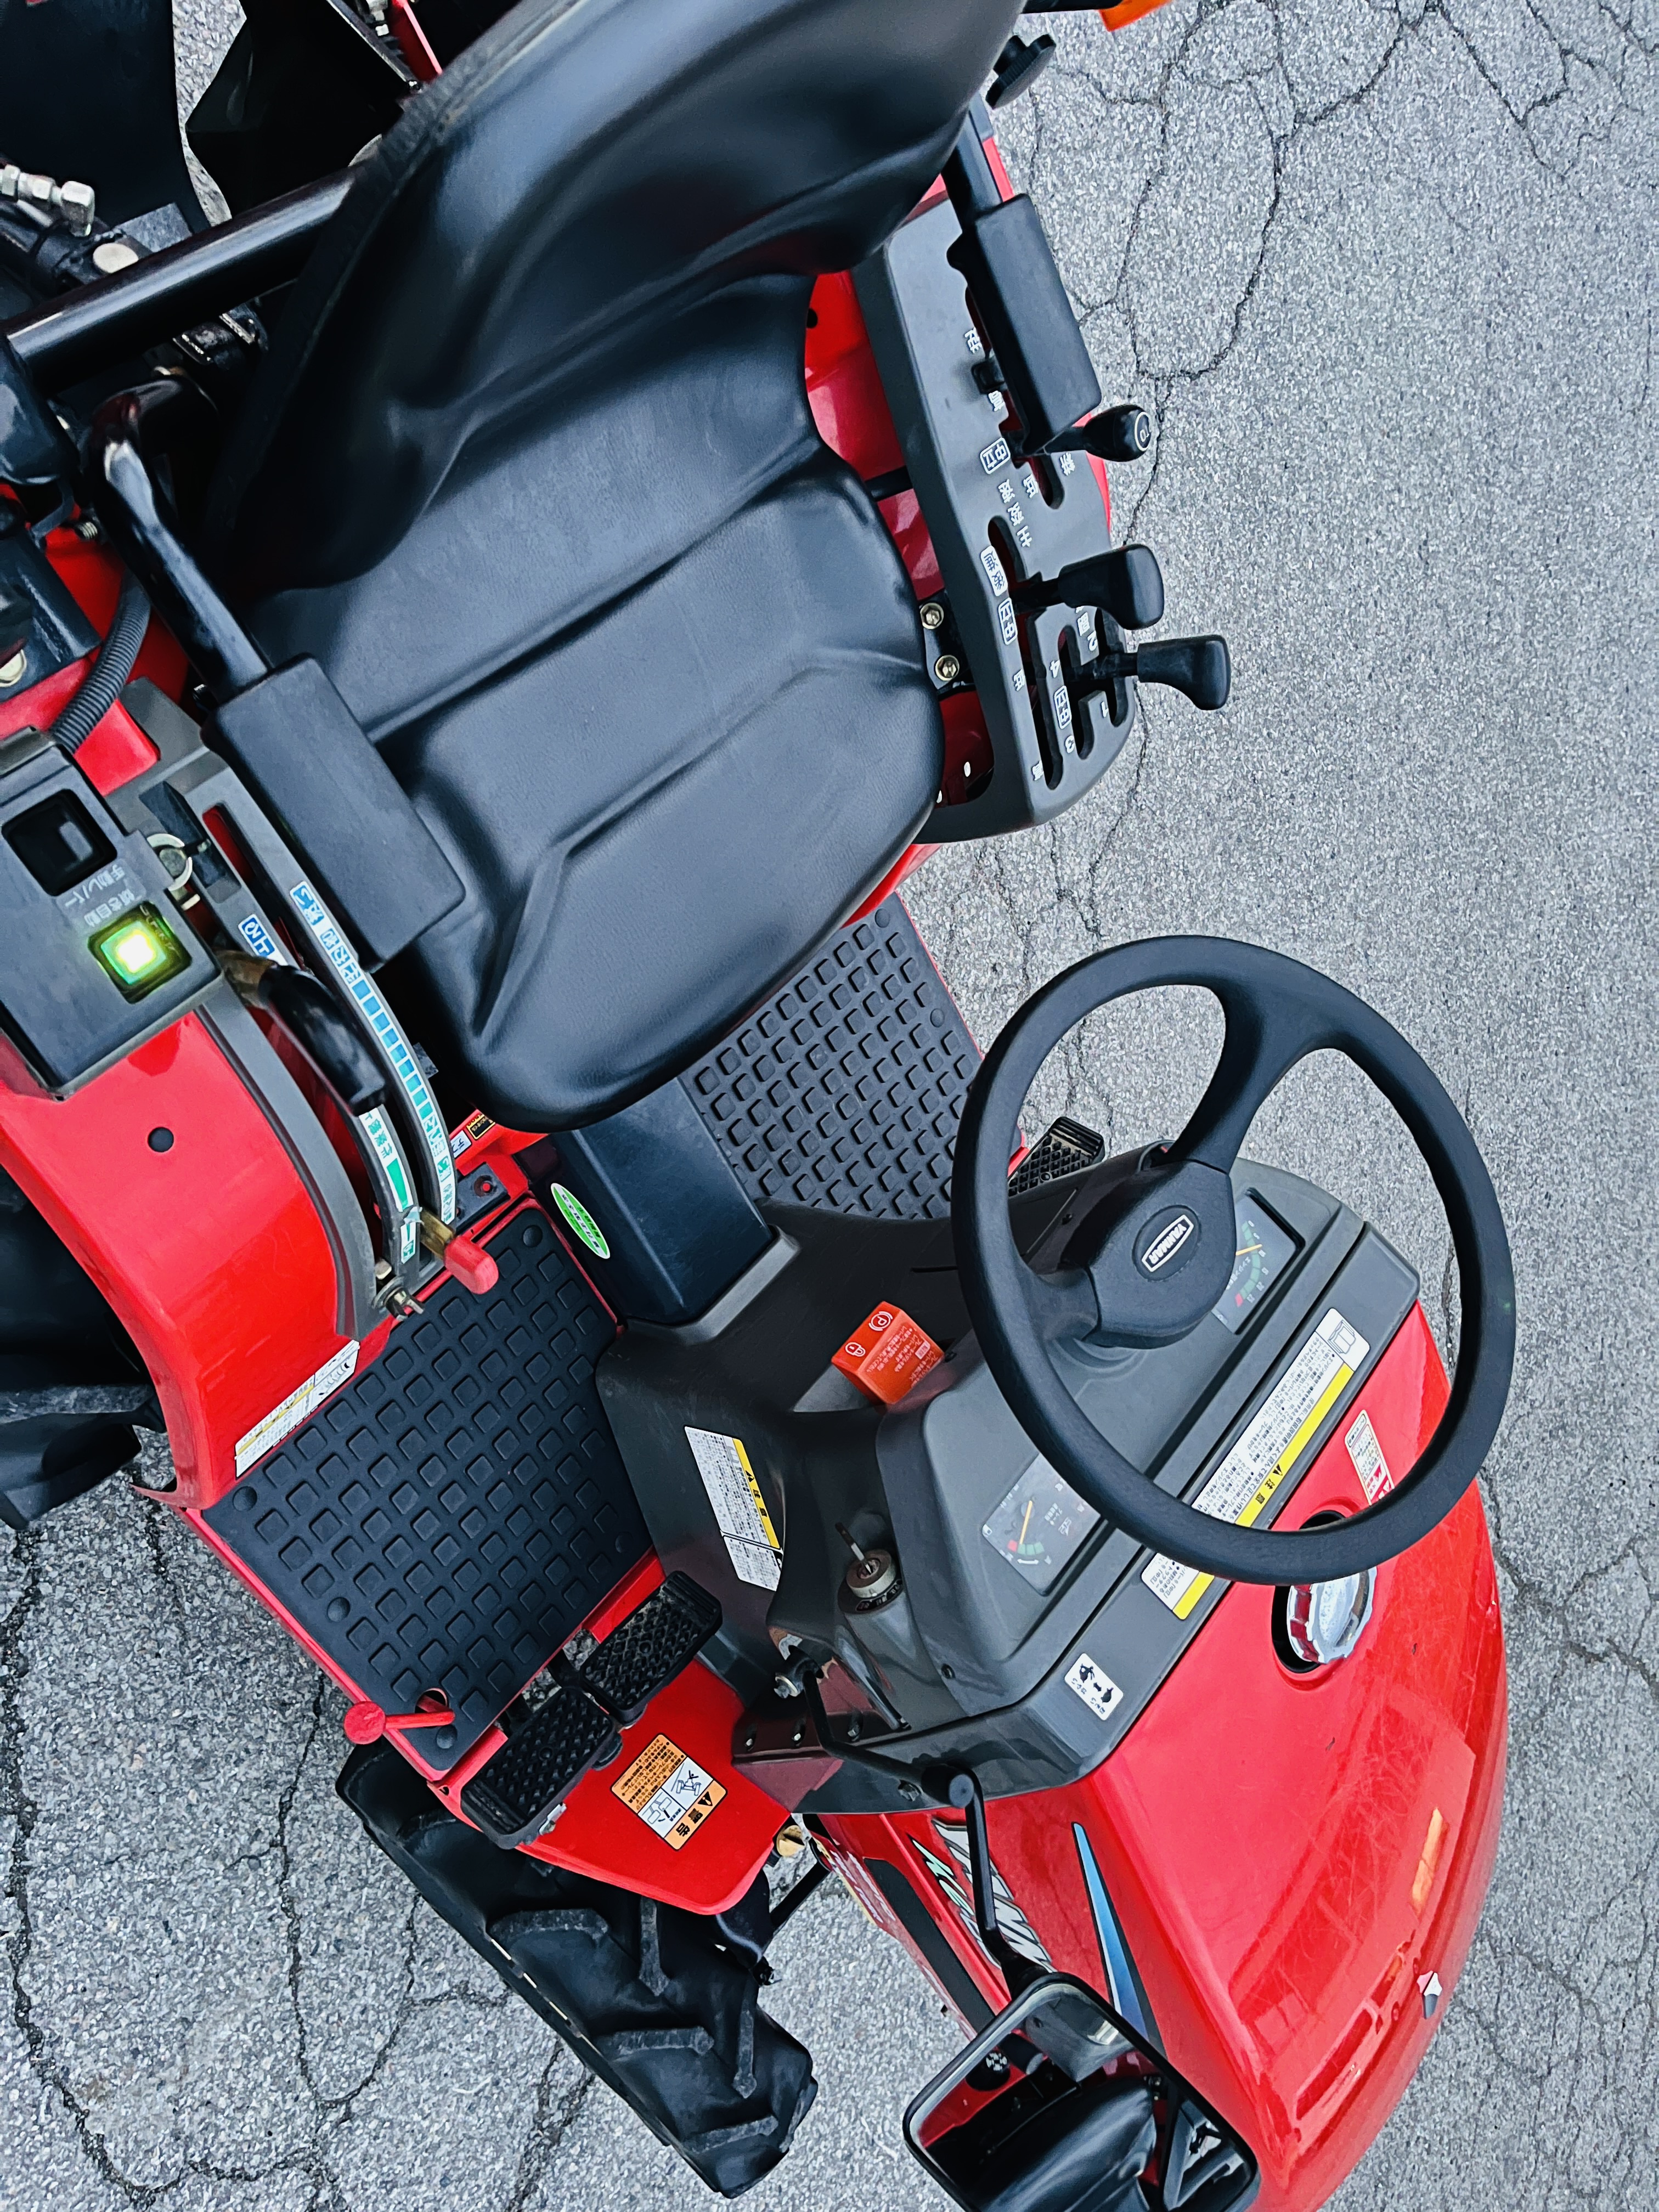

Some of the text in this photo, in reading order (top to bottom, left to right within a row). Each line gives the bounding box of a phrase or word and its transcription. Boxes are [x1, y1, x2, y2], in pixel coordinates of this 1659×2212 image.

[964, 327, 981, 353] 逆
[987, 389, 1004, 411] 高
[981, 442, 1007, 469] 中立
[1058, 453, 1076, 476] 耕
[1022, 473, 1039, 498] 低
[997, 478, 1034, 548] 主変速
[983, 550, 1005, 589] 後進
[998, 602, 1015, 639] 中立
[1087, 630, 1097, 651] 2
[1012, 668, 1026, 691] 低
[1049, 660, 1059, 678] 4
[1053, 691, 1070, 724] 中立
[1102, 702, 1107, 717] 1
[1064, 734, 1076, 753] 3
[1030, 760, 1045, 781] 高
[64, 862, 125, 910] 手動レバー
[83, 887, 136, 928] 傾き自動
[294, 887, 324, 924] 浅い
[242, 919, 274, 957] 上る
[320, 929, 361, 983] 代かき
[1148, 1224, 1186, 1264] YANMAR
[1254, 1478, 1275, 1504] 注意
[1154, 1566, 1172, 1589] トラクター
[675, 1807, 703, 1838] 警告
